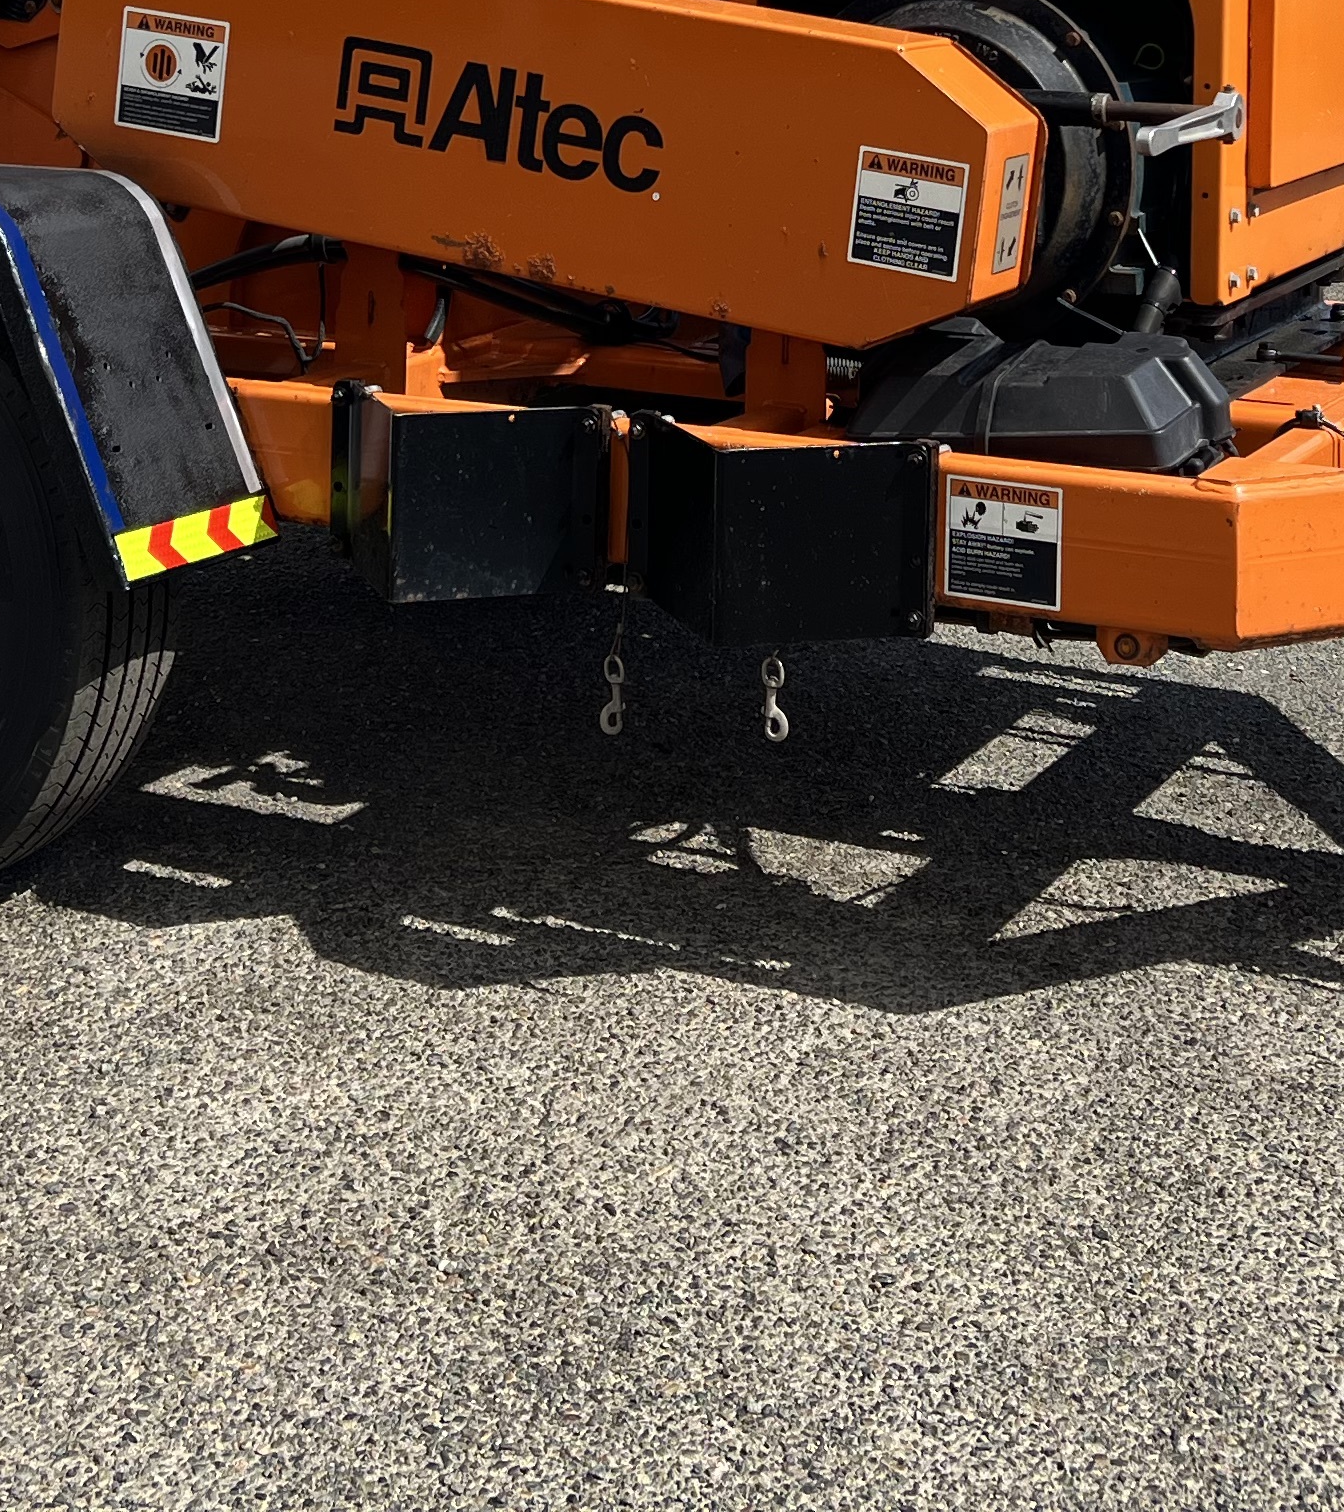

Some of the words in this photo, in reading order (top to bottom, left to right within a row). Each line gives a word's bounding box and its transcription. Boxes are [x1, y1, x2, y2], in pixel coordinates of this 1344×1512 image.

[154, 18, 215, 38] WARNING
[427, 61, 663, 193] Altec
[887, 158, 955, 181] WARNING
[860, 197, 911, 212] ENTANGLEMENT
[859, 204, 876, 212] Death
[883, 208, 904, 217] serious
[904, 212, 920, 221] injury
[921, 215, 938, 223] could
[938, 218, 955, 227] result
[872, 213, 910, 226] entanglement
[910, 220, 923, 228] with
[923, 222, 934, 230] belt
[855, 238, 871, 246] place
[871, 240, 882, 248] and
[902, 246, 920, 256] before
[856, 231, 876, 240] Ensure
[876, 235, 896, 244] guards
[896, 237, 908, 246] and
[908, 241, 927, 250] covers
[872, 255, 905, 267] CLOTHING
[905, 261, 928, 271] CLEAR
[873, 247, 890, 256] KEEP
[891, 251, 914, 260] HANDS
[914, 255, 929, 263] AND
[976, 485, 1050, 506] WARNING
[951, 530, 987, 541] EXPLOSION
[951, 538, 967, 546] STAY
[951, 546, 966, 554] ACID
[966, 548, 984, 557] BURN
